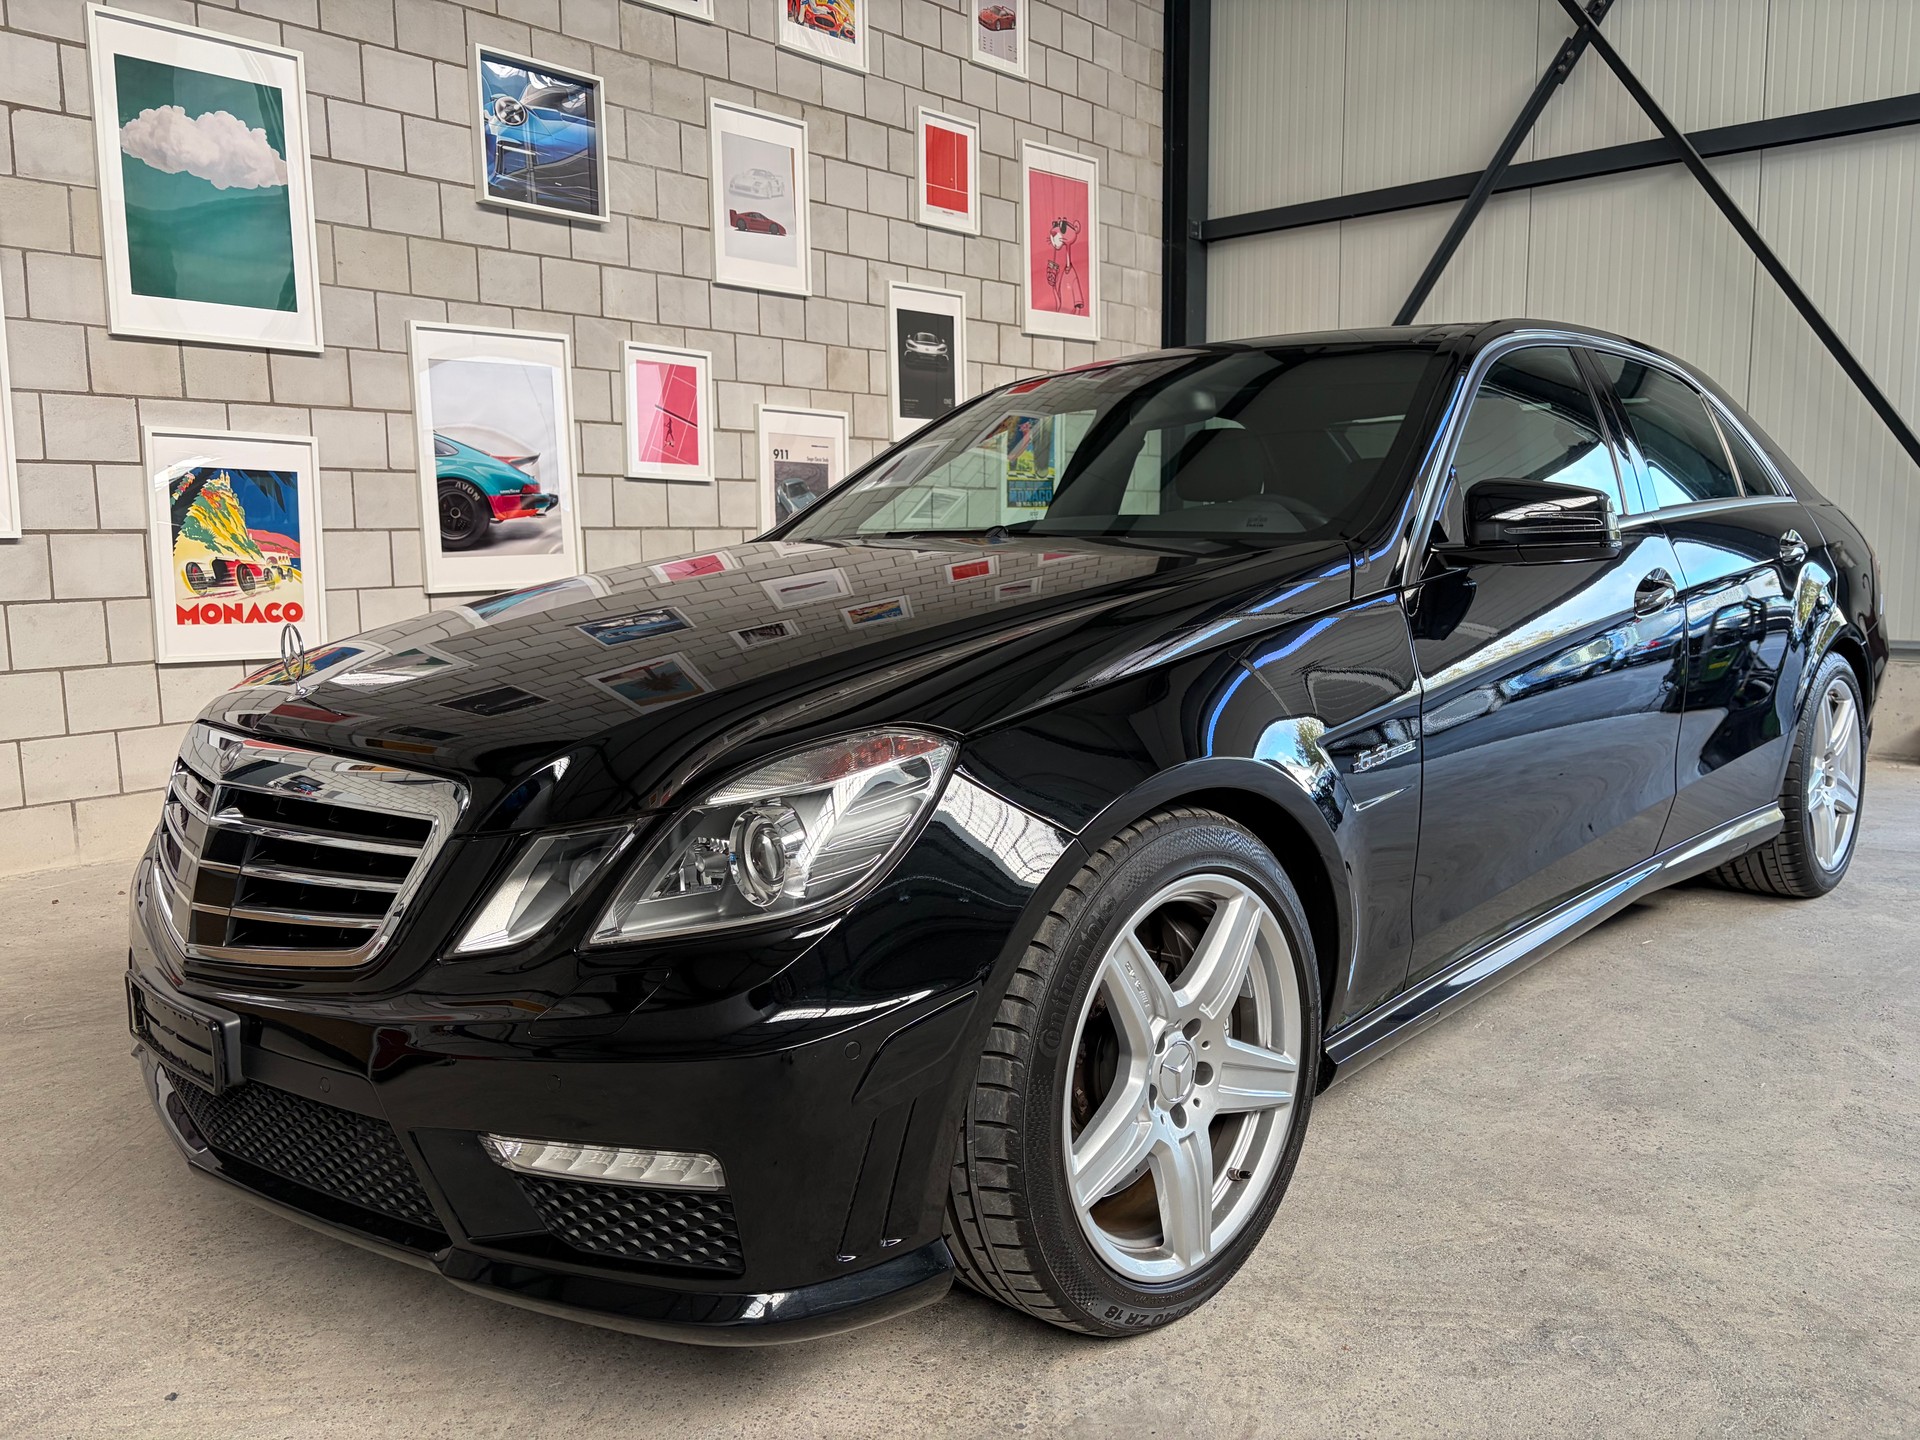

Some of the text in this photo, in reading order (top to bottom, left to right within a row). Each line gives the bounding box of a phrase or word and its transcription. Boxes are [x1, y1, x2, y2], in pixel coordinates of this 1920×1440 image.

[773, 449, 789, 460] 911
[455, 481, 480, 501] AVON
[176, 602, 303, 625] MONACO
[1039, 910, 1107, 1057] Continental
[1104, 1305, 1124, 1320] 18
[1125, 1312, 1150, 1326] ZR
